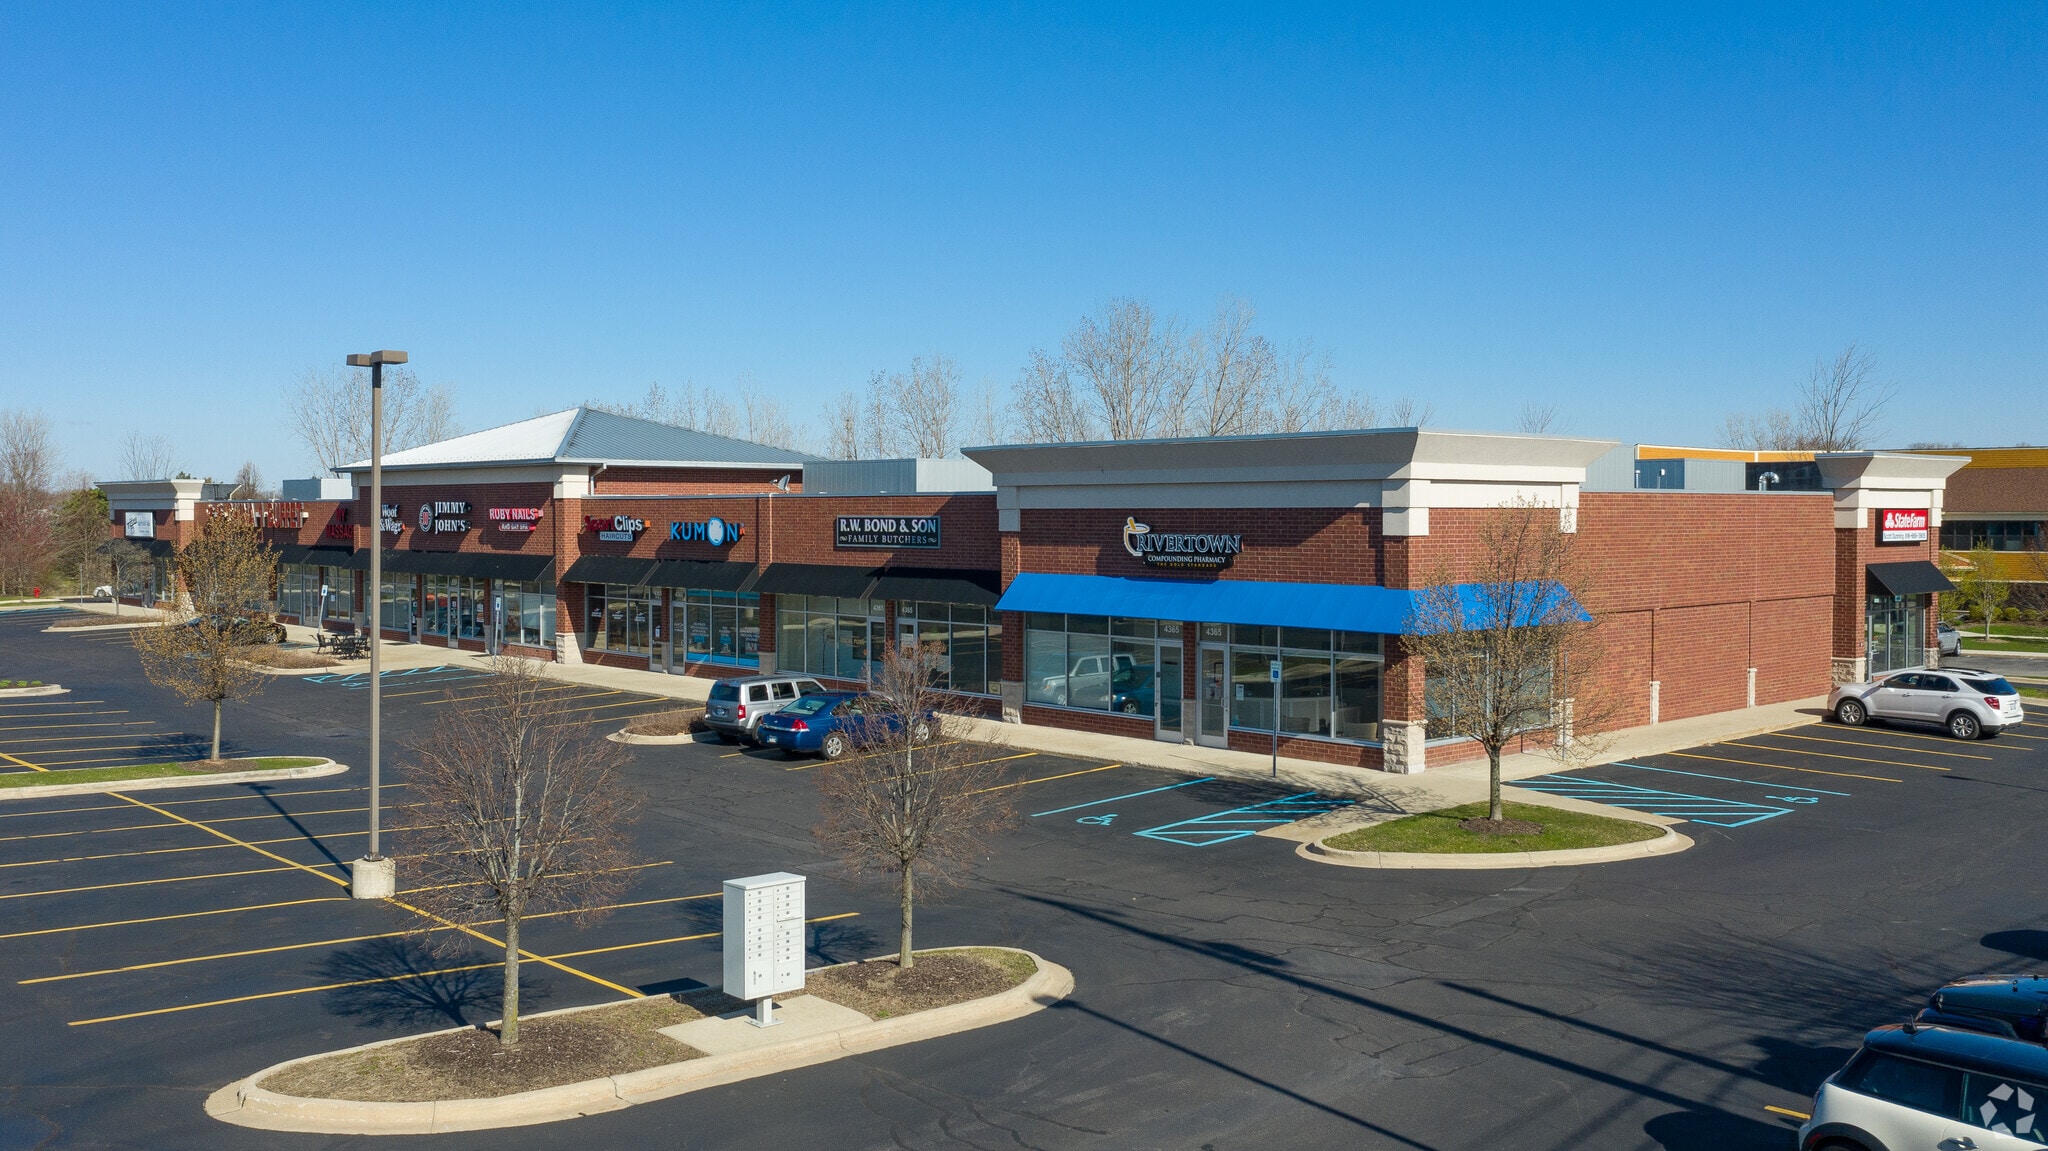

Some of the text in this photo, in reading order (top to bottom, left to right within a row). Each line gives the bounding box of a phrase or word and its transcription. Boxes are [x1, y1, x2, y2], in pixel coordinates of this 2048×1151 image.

[382, 504, 398, 518] Woof
[435, 502, 465, 517] JIMMY
[489, 508, 535, 520] RUBY NAILS
[326, 524, 354, 539] MASSAG
[435, 520, 466, 535] JOHN'S
[670, 517, 739, 547] KUMON
[840, 519, 936, 533] R.W. BOND & SON
[601, 532, 632, 541] HAIRCUTS
[848, 535, 927, 544] FAMILY BUTCHERS
[1136, 533, 1241, 553] RIVERTOWN
[1147, 555, 1226, 564] COMPOUNDING PHARMACY
